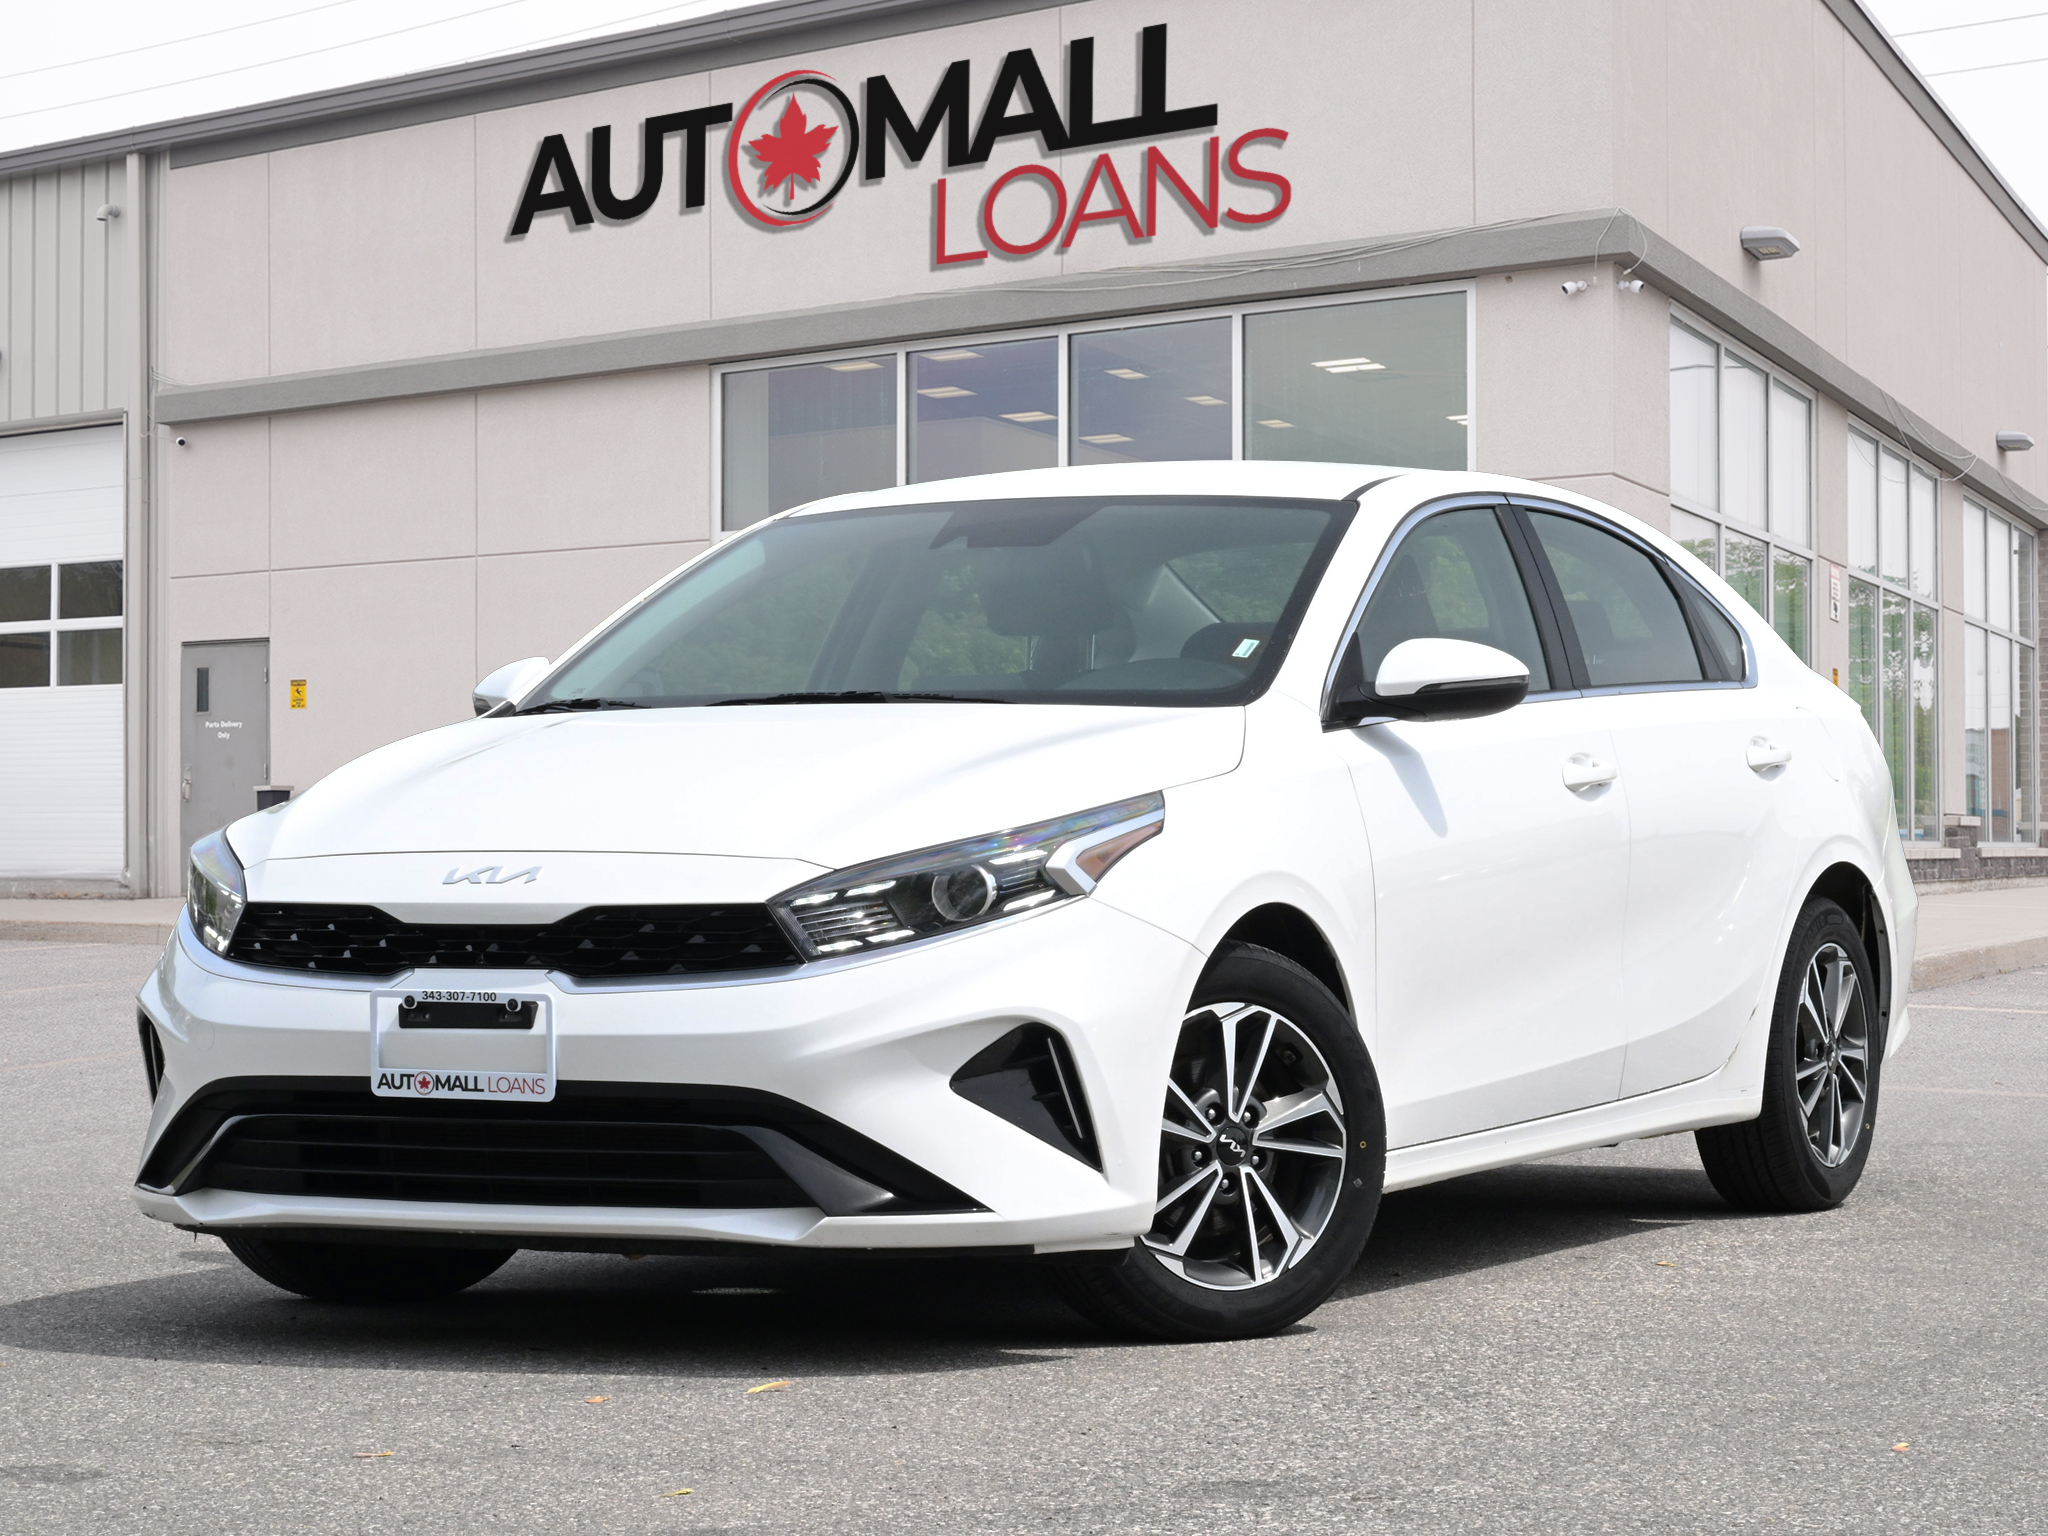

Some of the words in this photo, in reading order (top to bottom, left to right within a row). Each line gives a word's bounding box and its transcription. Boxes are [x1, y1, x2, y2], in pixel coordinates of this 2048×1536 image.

[509, 23, 1218, 236] AUTOMALL
[936, 128, 1292, 265] LOANS
[217, 731, 230, 740] Only
[421, 990, 497, 1002] 343-307-7100
[377, 1071, 484, 1095] AUTOMALL
[488, 1076, 546, 1095] LOANS
